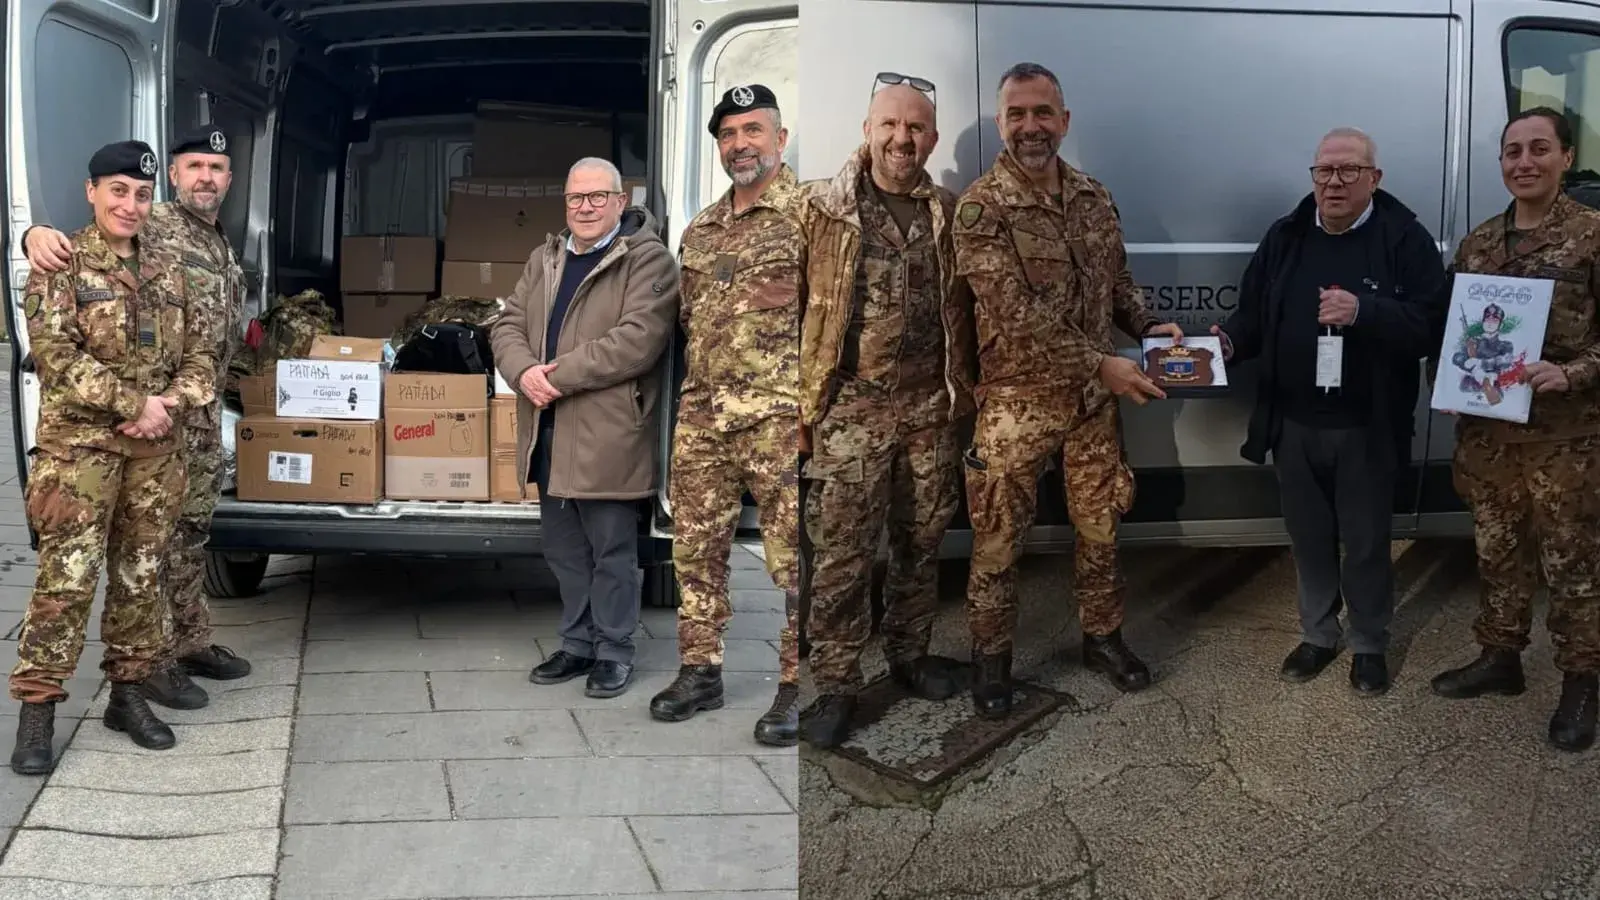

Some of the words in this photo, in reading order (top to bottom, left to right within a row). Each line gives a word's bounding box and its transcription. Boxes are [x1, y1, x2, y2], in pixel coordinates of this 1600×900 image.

[1140, 285, 1238, 311] ESERC
[398, 383, 446, 401] PATTADA
[394, 420, 435, 441] General
